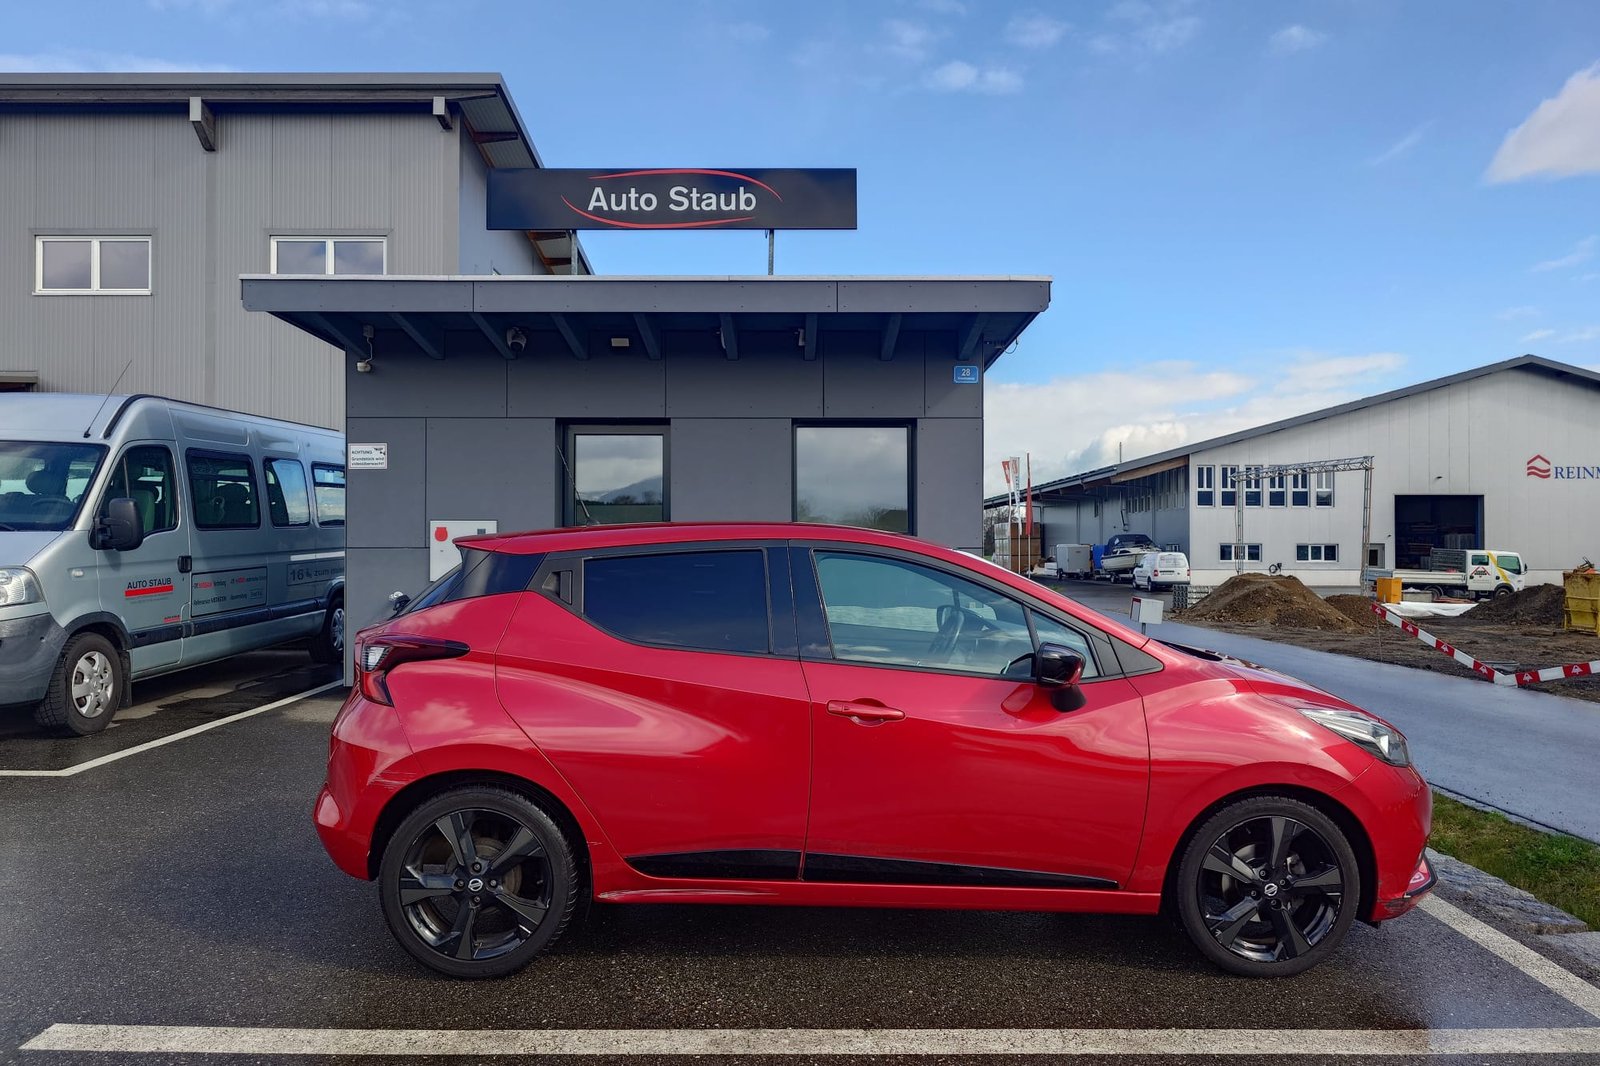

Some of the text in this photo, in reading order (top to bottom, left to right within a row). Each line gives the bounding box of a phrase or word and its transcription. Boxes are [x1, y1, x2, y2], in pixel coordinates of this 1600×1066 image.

[588, 186, 756, 211] Auto Staub
[961, 368, 971, 376] 28
[127, 577, 172, 590] AUTO STAUB
